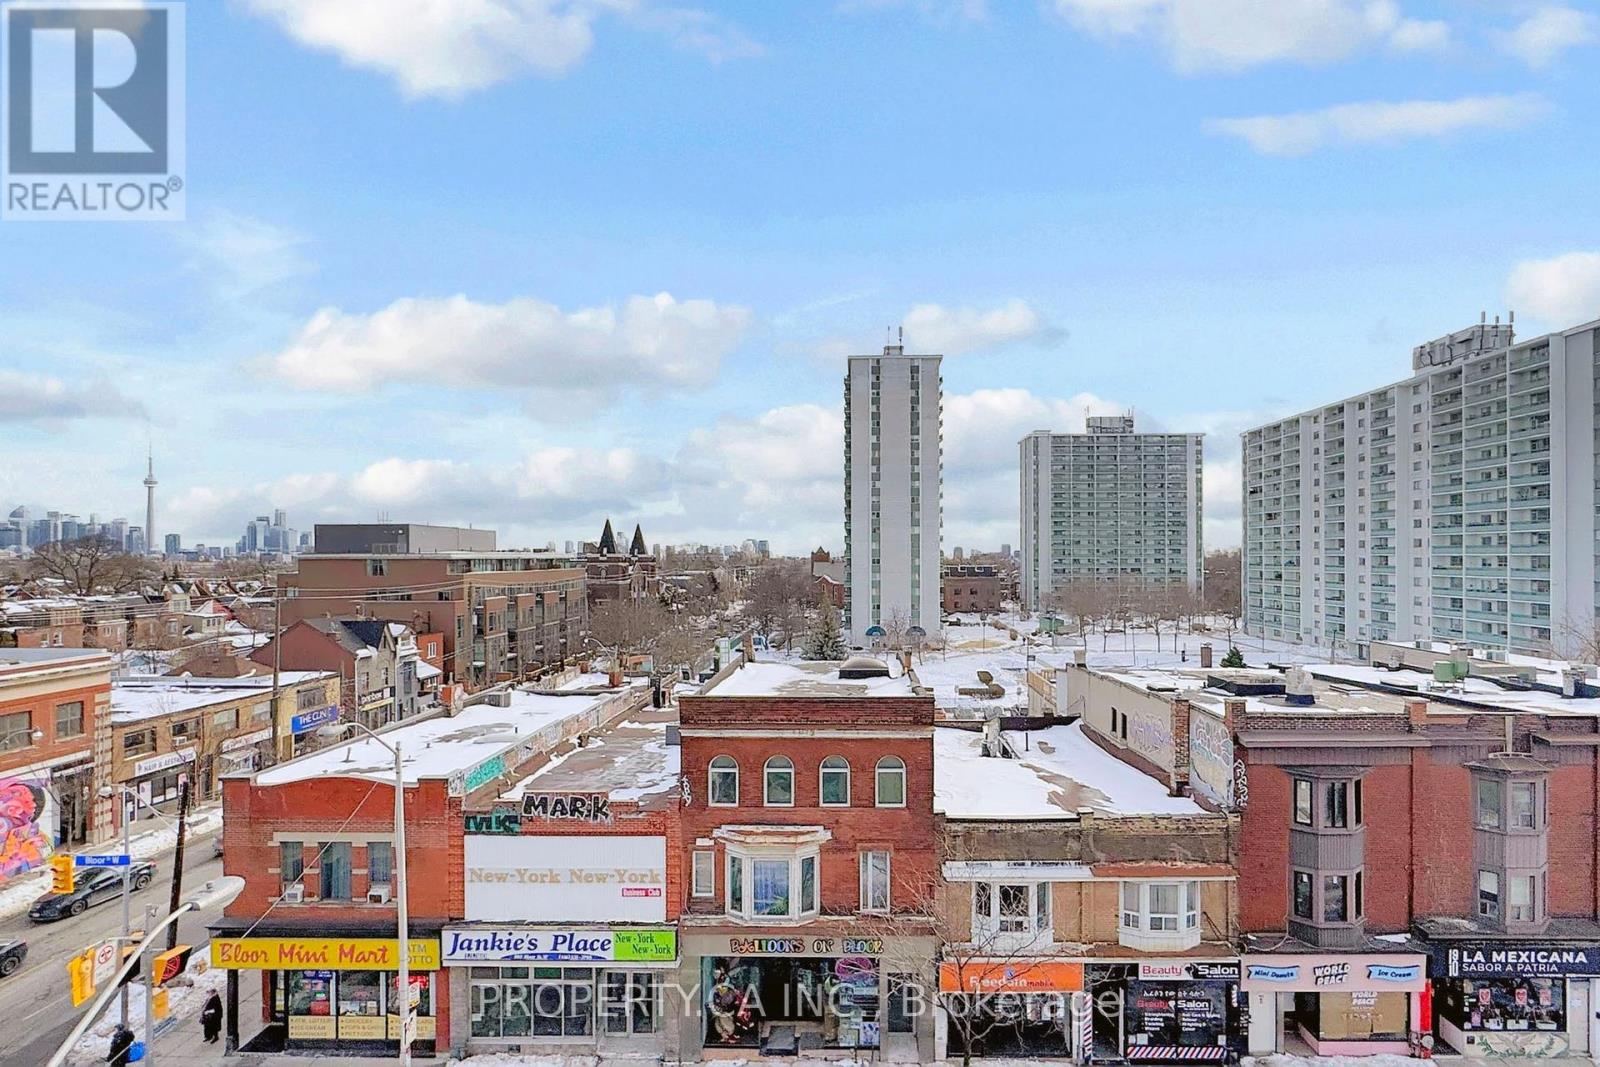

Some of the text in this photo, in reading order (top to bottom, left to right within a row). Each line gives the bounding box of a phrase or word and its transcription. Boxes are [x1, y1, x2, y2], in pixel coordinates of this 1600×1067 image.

[300, 714, 312, 725] THE
[84, 856, 105, 864] Bloor
[112, 856, 120, 864] W
[469, 868, 661, 884] New-York New-York
[648, 889, 661, 897] Club
[447, 932, 612, 956] Jankie's Place
[615, 933, 631, 943] New
[638, 933, 655, 944] York
[632, 944, 648, 954] New
[655, 944, 672, 955] York
[812, 938, 834, 953] ON
[219, 942, 389, 964] Bloor Mini Mart
[1462, 951, 1588, 963] LA MEXICANA
[1142, 964, 1239, 977] Beauty Salon
[1314, 963, 1351, 977] WORLD
[1462, 963, 1558, 972] SABOR A PATRIA
[1315, 973, 1349, 986] PEACE
[1136, 1000, 1209, 1010] Beauty Salon
